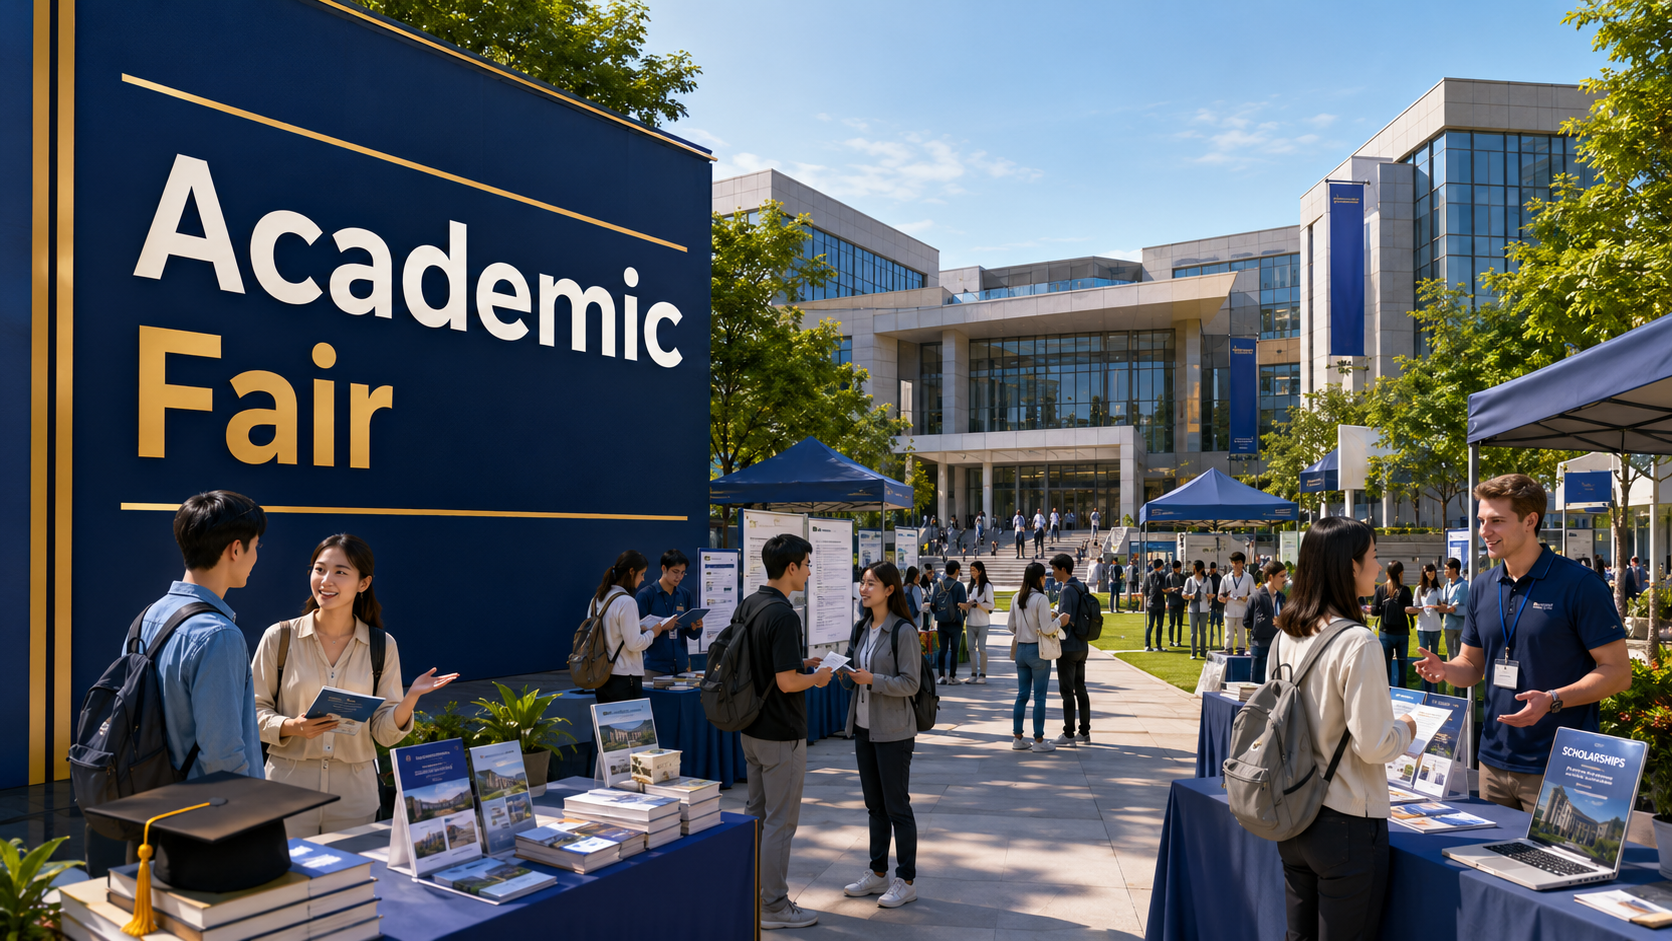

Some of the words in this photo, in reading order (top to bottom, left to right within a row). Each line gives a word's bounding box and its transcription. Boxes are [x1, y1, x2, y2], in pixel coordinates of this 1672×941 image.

[133, 153, 683, 368] Academic
[138, 325, 393, 469] Fair
[1561, 746, 1626, 768] SCHOLARSHIPS
